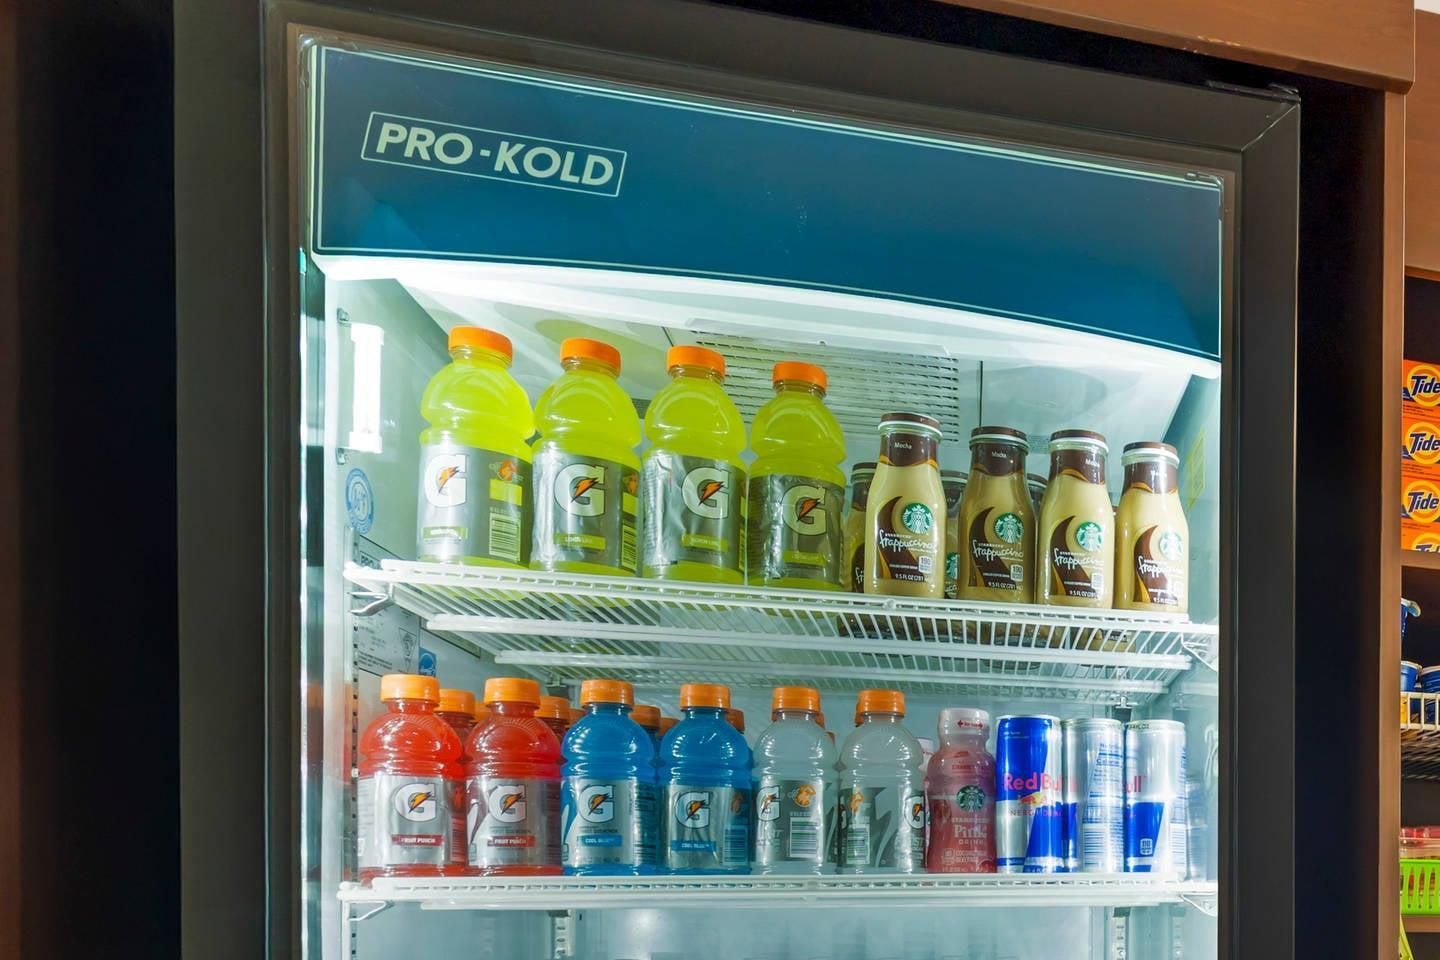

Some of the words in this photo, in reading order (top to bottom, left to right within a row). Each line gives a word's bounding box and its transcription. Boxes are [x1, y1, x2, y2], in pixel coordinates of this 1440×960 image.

[375, 121, 615, 187] PRO-KOLD
[1410, 434, 1440, 453] Tide
[554, 464, 608, 517] G
[682, 467, 730, 519] G
[1408, 492, 1439, 512] Tide
[782, 485, 826, 535] G
[1003, 772, 1037, 790] Red
[394, 783, 436, 822] G
[488, 784, 528, 823] G
[579, 785, 615, 823] G
[674, 791, 711, 829] G
[756, 785, 781, 821] G
